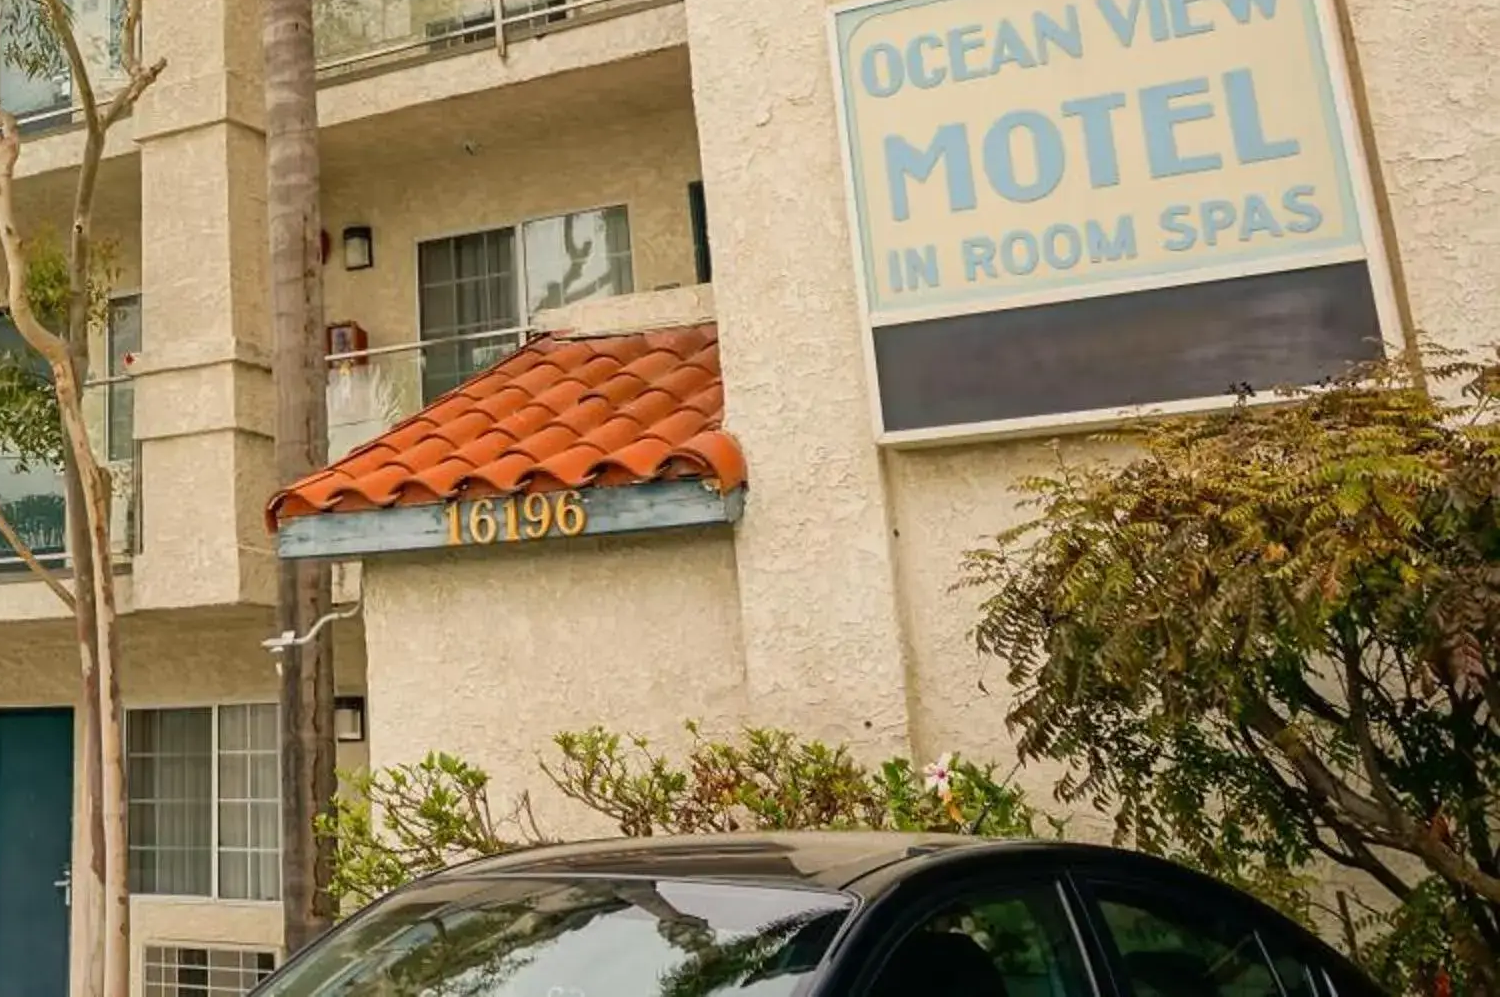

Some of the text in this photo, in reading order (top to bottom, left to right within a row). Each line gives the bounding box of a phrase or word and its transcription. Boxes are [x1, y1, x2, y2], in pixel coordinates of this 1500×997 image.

[860, 3, 1083, 97] OCEAN
[884, 68, 1299, 221] MOTEL
[888, 185, 1323, 292] IN ROOM SPAS
[445, 490, 586, 546] 16196
